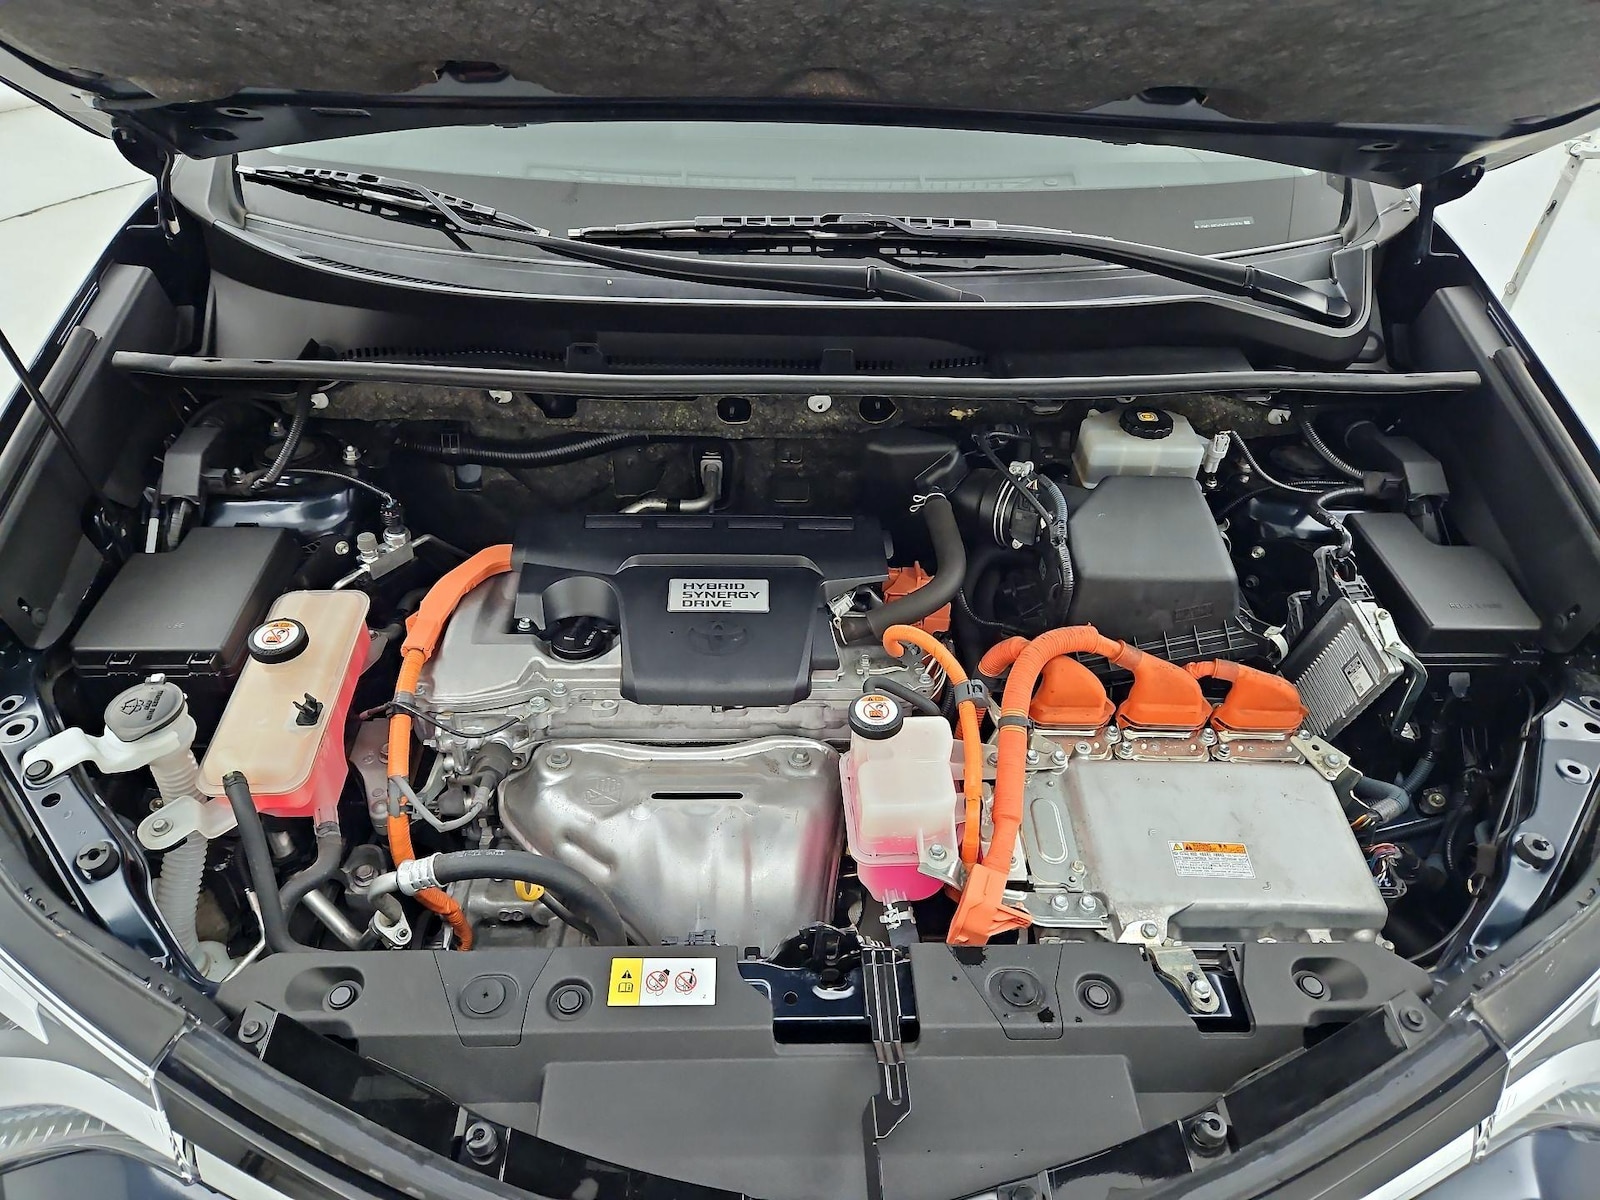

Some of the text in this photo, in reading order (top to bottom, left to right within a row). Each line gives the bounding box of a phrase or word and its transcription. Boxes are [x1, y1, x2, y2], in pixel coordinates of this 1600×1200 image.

[682, 582, 745, 590] HYBRID
[682, 591, 760, 599] SYNERGY
[682, 600, 732, 608] DRIVE
